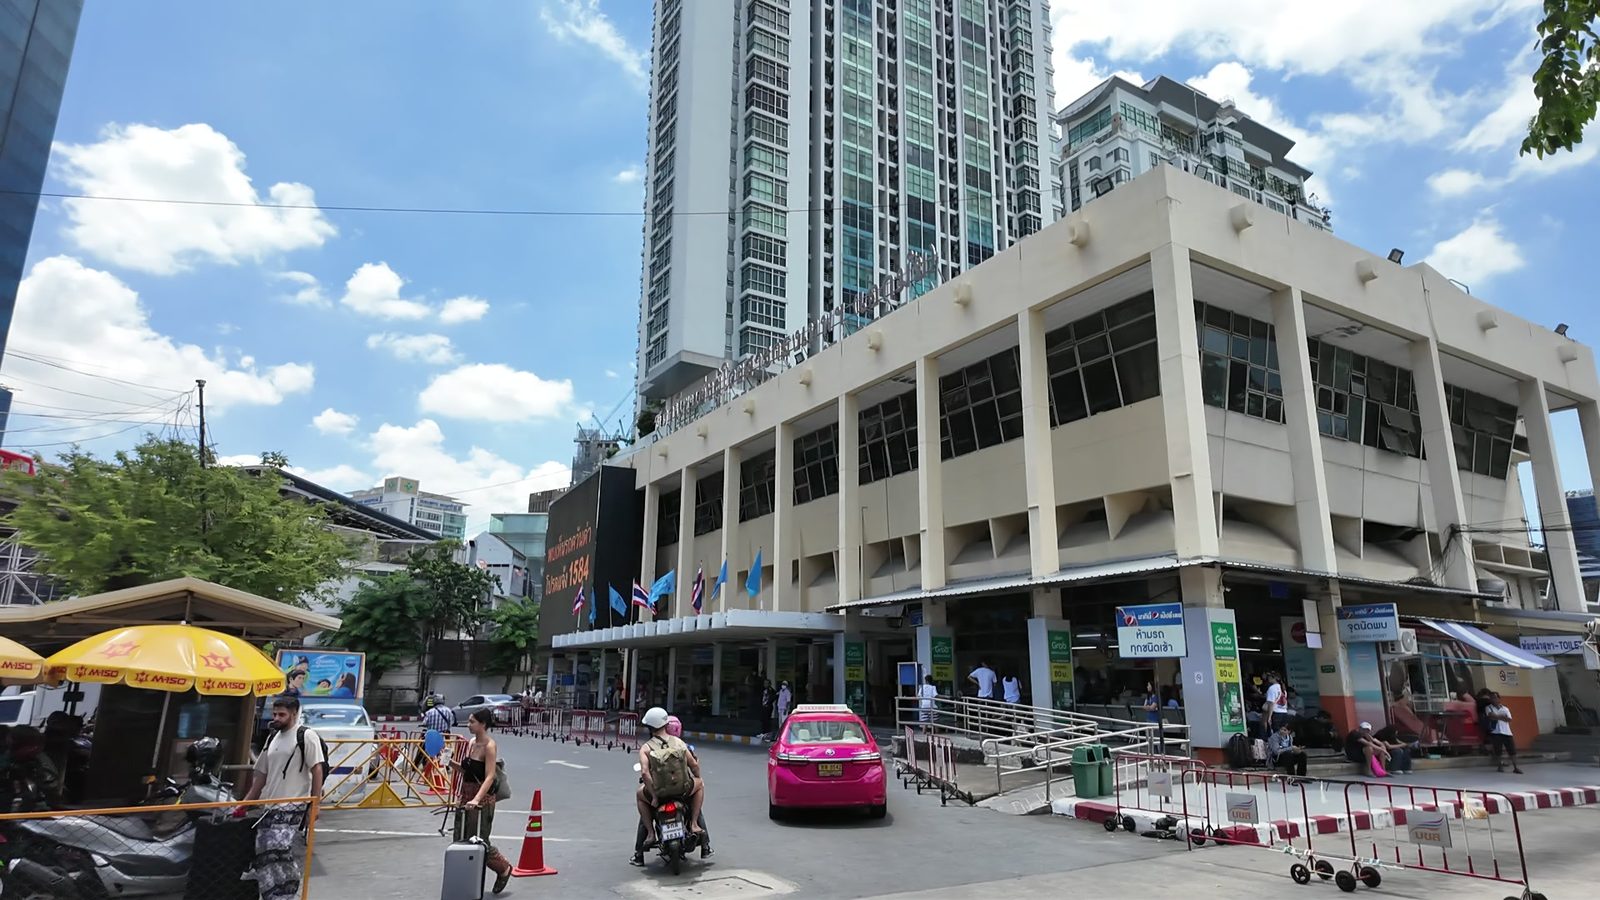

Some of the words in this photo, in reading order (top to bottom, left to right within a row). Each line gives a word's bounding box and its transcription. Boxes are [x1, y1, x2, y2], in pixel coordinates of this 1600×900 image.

[569, 554, 590, 587] 1584
[1347, 620, 1388, 633] จุดนัดพบ
[1136, 629, 1165, 639] ห้ามรถ
[1215, 634, 1232, 645] Grab
[934, 645, 950, 654] Grab
[1051, 641, 1067, 650] Grab
[1130, 641, 1174, 655] ทุกชนิดเข้า
[1219, 669, 1228, 678] 80
